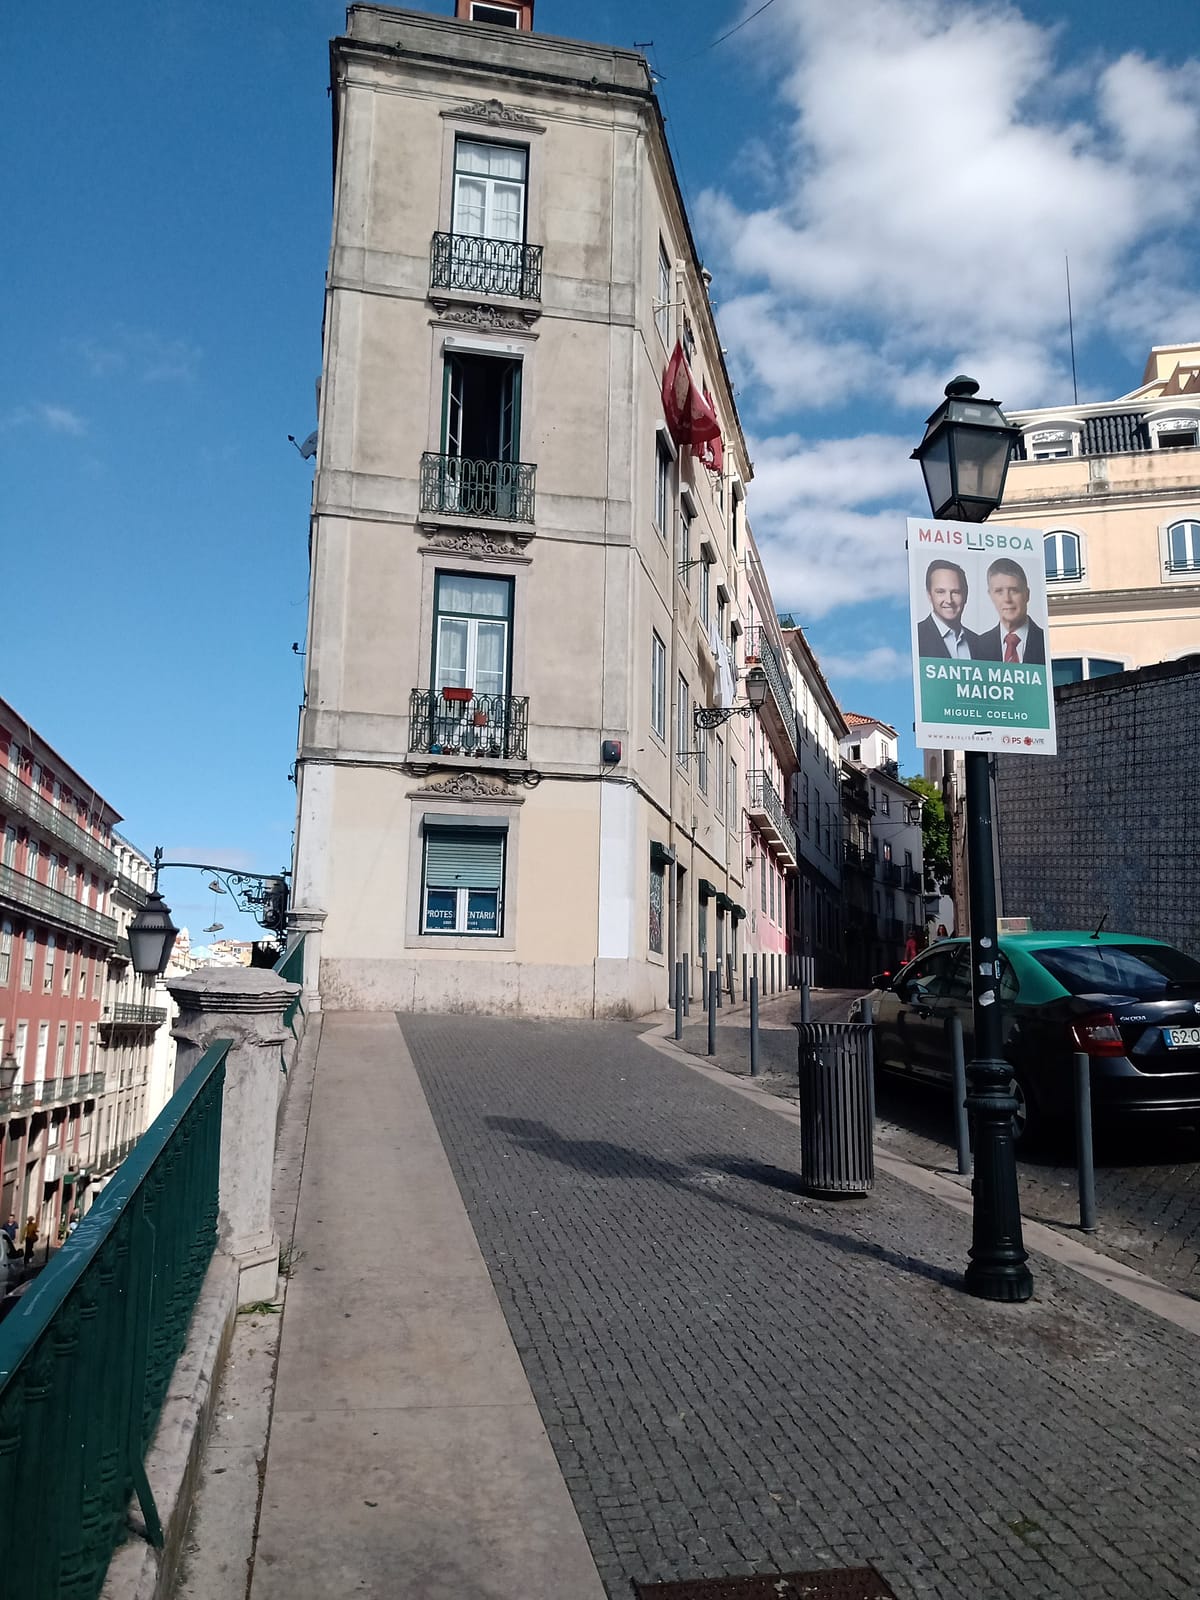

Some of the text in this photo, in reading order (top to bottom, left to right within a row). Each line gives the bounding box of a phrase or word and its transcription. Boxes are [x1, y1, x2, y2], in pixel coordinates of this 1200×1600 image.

[918, 528, 1034, 551] MAIS LISBOA
[925, 664, 1043, 686] SANTA MARIA
[956, 683, 1015, 701] MAIOR
[943, 708, 1029, 721] MIGUEL COELHO
[1011, 737, 1022, 745] PS
